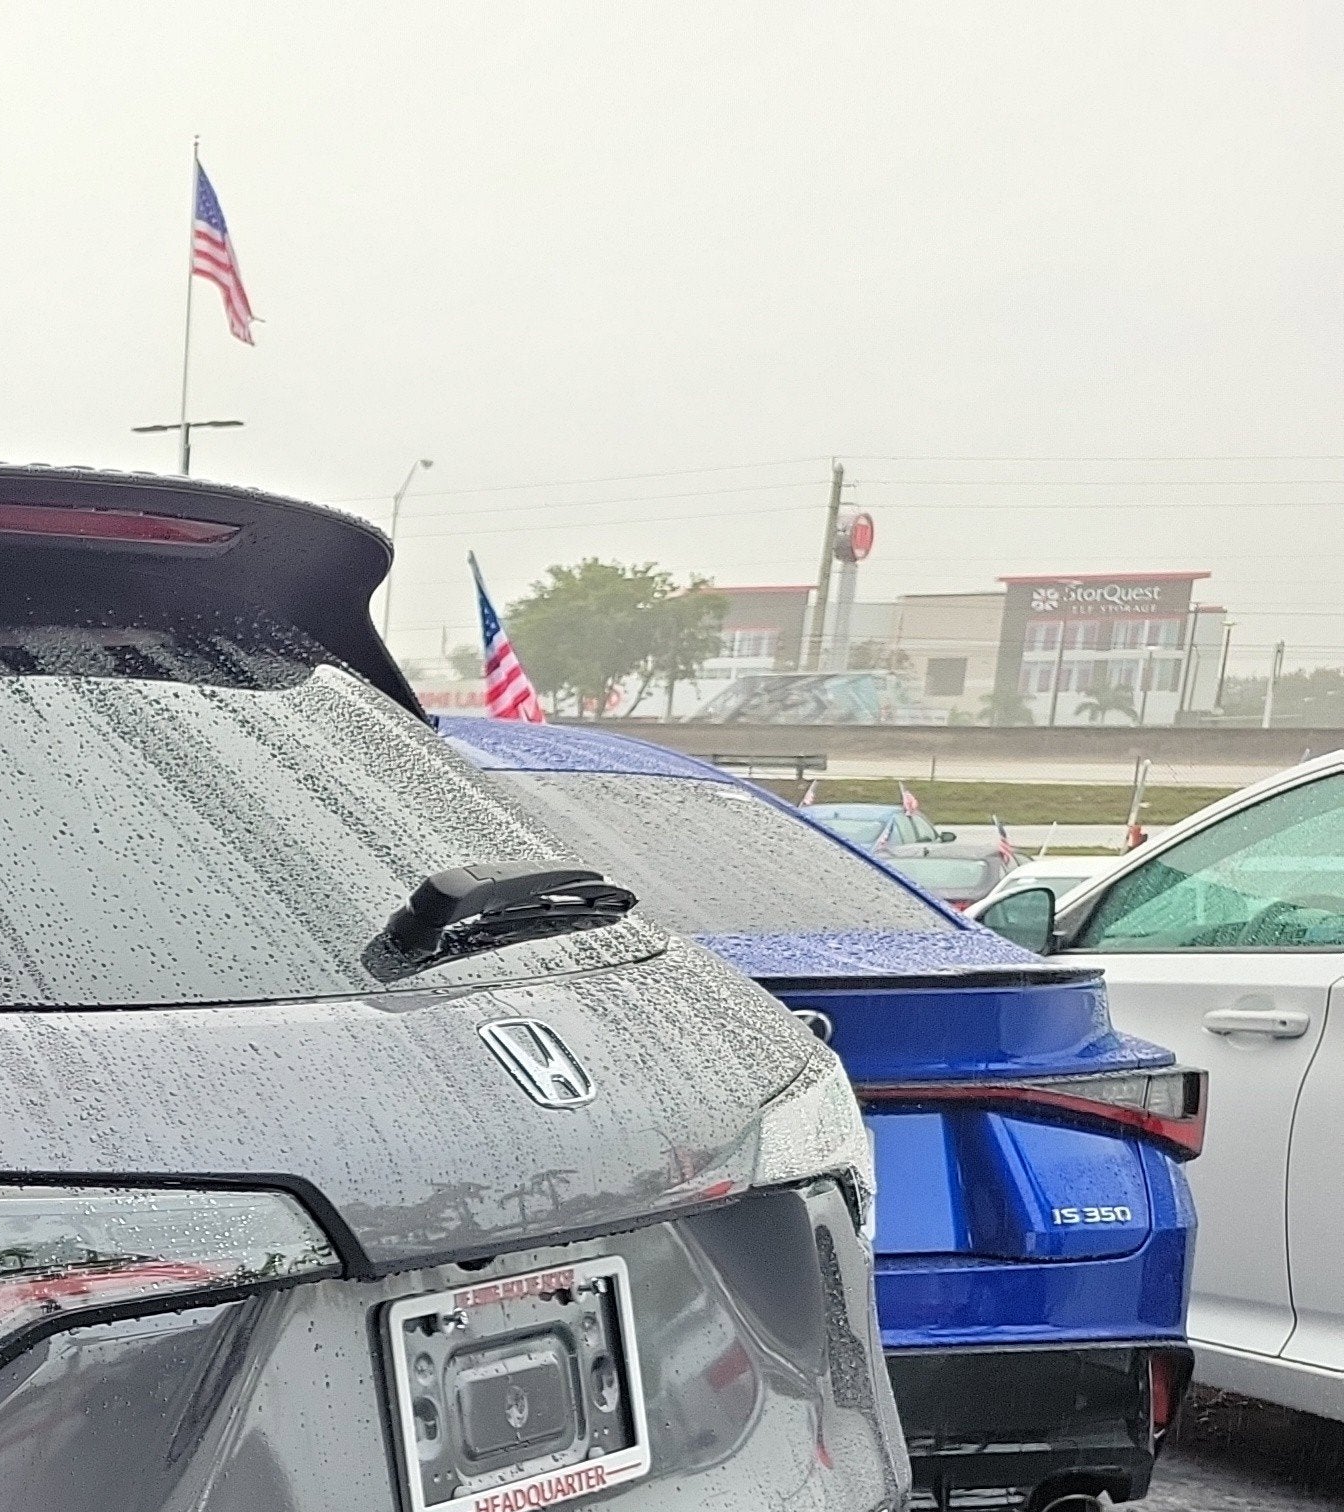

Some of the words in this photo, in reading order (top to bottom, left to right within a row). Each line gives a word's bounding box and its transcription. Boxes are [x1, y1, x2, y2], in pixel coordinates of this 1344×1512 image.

[1063, 584, 1161, 605] StorQuest
[1051, 1207, 1080, 1225] IS
[1081, 1205, 1132, 1223] 350
